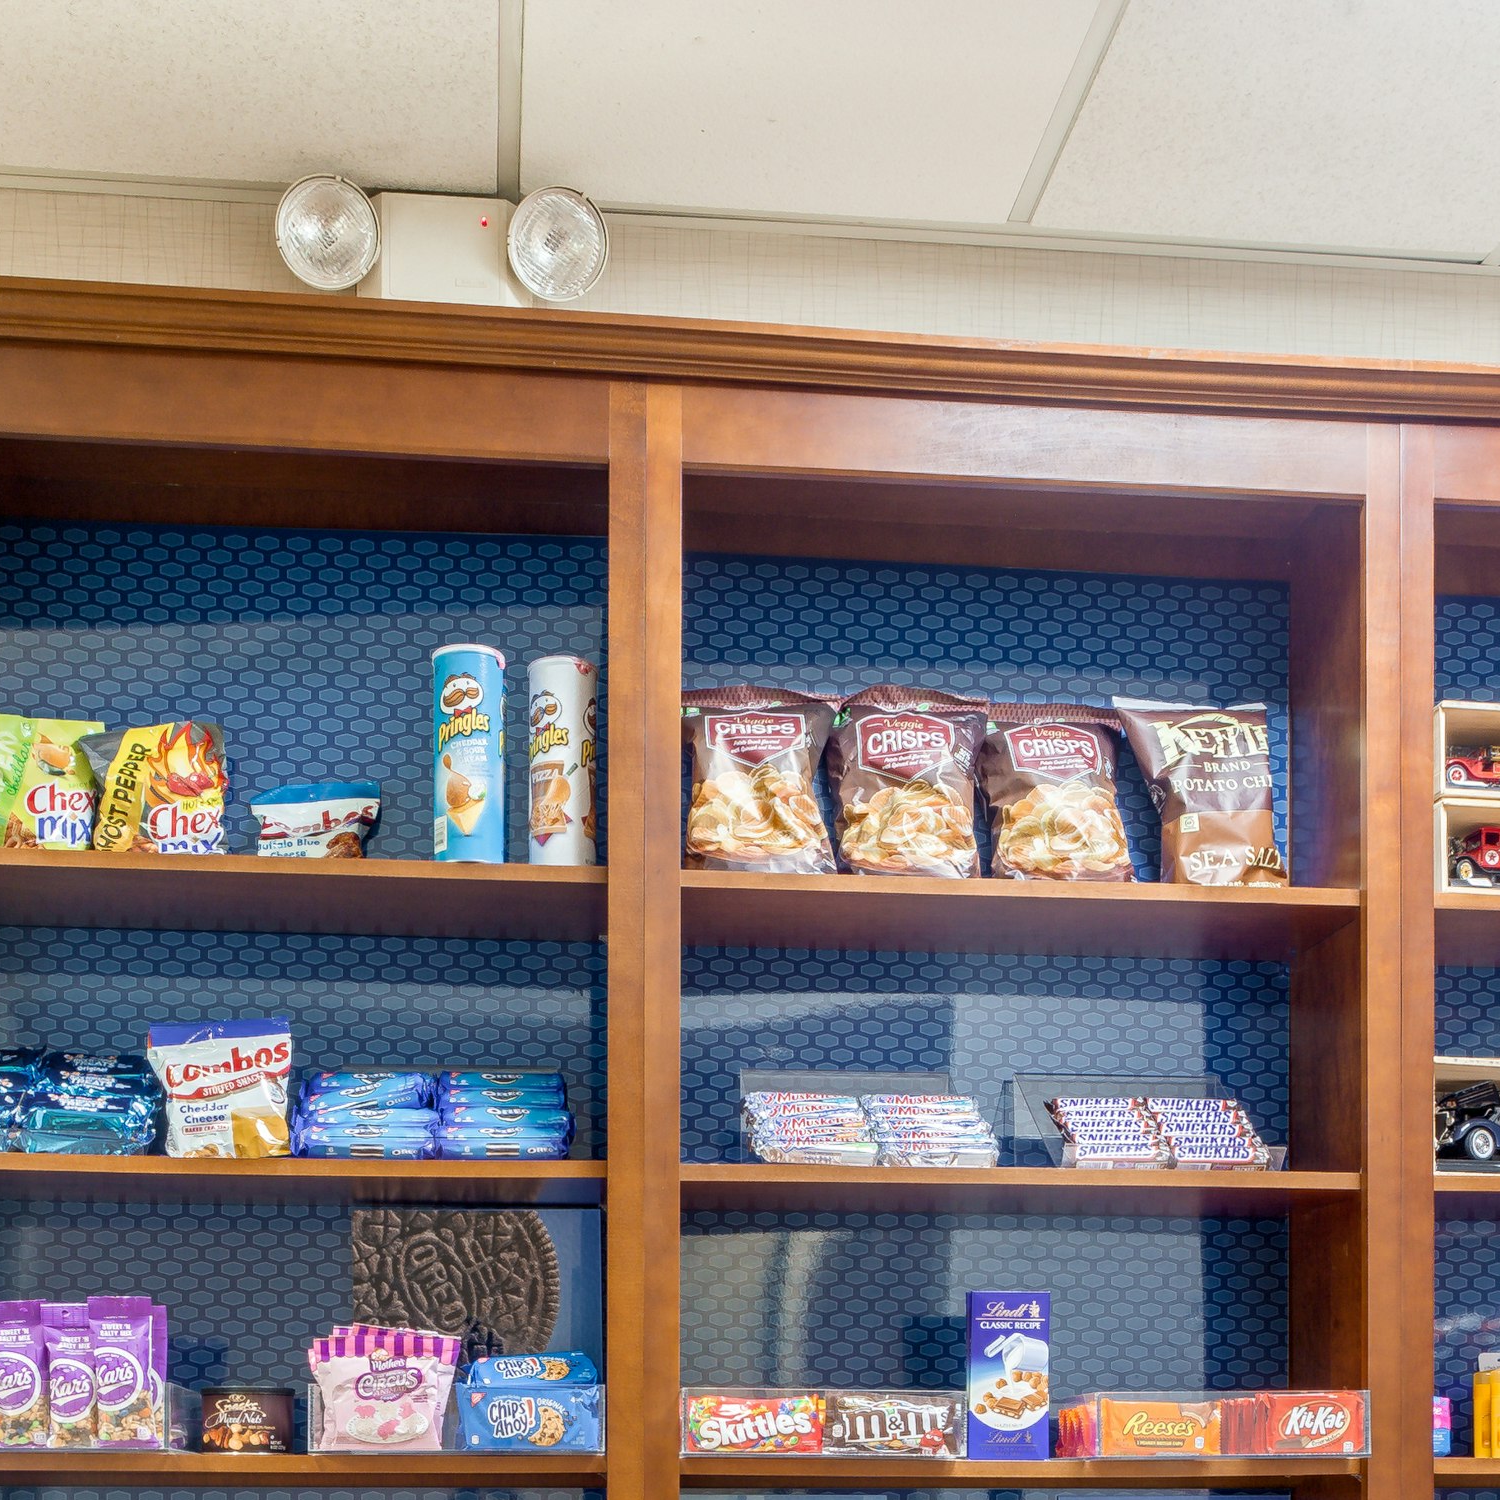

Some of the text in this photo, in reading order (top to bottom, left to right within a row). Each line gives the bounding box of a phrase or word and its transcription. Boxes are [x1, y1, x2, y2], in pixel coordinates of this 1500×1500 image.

[437, 708, 491, 754] Pringles
[714, 721, 797, 736] CRISPS
[883, 717, 925, 732] Veggie
[1030, 726, 1071, 739] Veggie
[463, 746, 486, 756] SOUR
[867, 729, 947, 755] CRISPS
[1017, 738, 1095, 758] CRISPS
[113, 742, 153, 805] PEPPER
[1204, 760, 1251, 773] BRAND
[1172, 778, 1238, 795] POTATO
[26, 784, 96, 816] Chex
[37, 813, 94, 846] mix
[149, 806, 221, 841] Chex
[296, 838, 322, 848] Blue
[1189, 845, 1283, 873] SEA SALT
[165, 1042, 290, 1089] Combos
[179, 1103, 230, 1115] Cheddar
[1149, 1099, 1224, 1112] SNICKERS
[184, 1113, 228, 1125] Cheese
[1177, 1146, 1251, 1160] SNICKERS
[407, 1242, 467, 1331] OREO
[982, 1300, 1030, 1318] Lindt
[979, 1321, 1042, 1330] CLASSIC RECIPE
[495, 1358, 531, 1373] Chips
[50, 1375, 92, 1399] Kar's
[357, 1368, 419, 1398] CIRCUS
[488, 1398, 527, 1424] Chips
[536, 1397, 567, 1415] ORIGINAL
[242, 1411, 263, 1425] Nuts
[1122, 1411, 1196, 1438] Reese's
[1283, 1404, 1346, 1436] KitKat
[698, 1410, 815, 1452] Skittles
